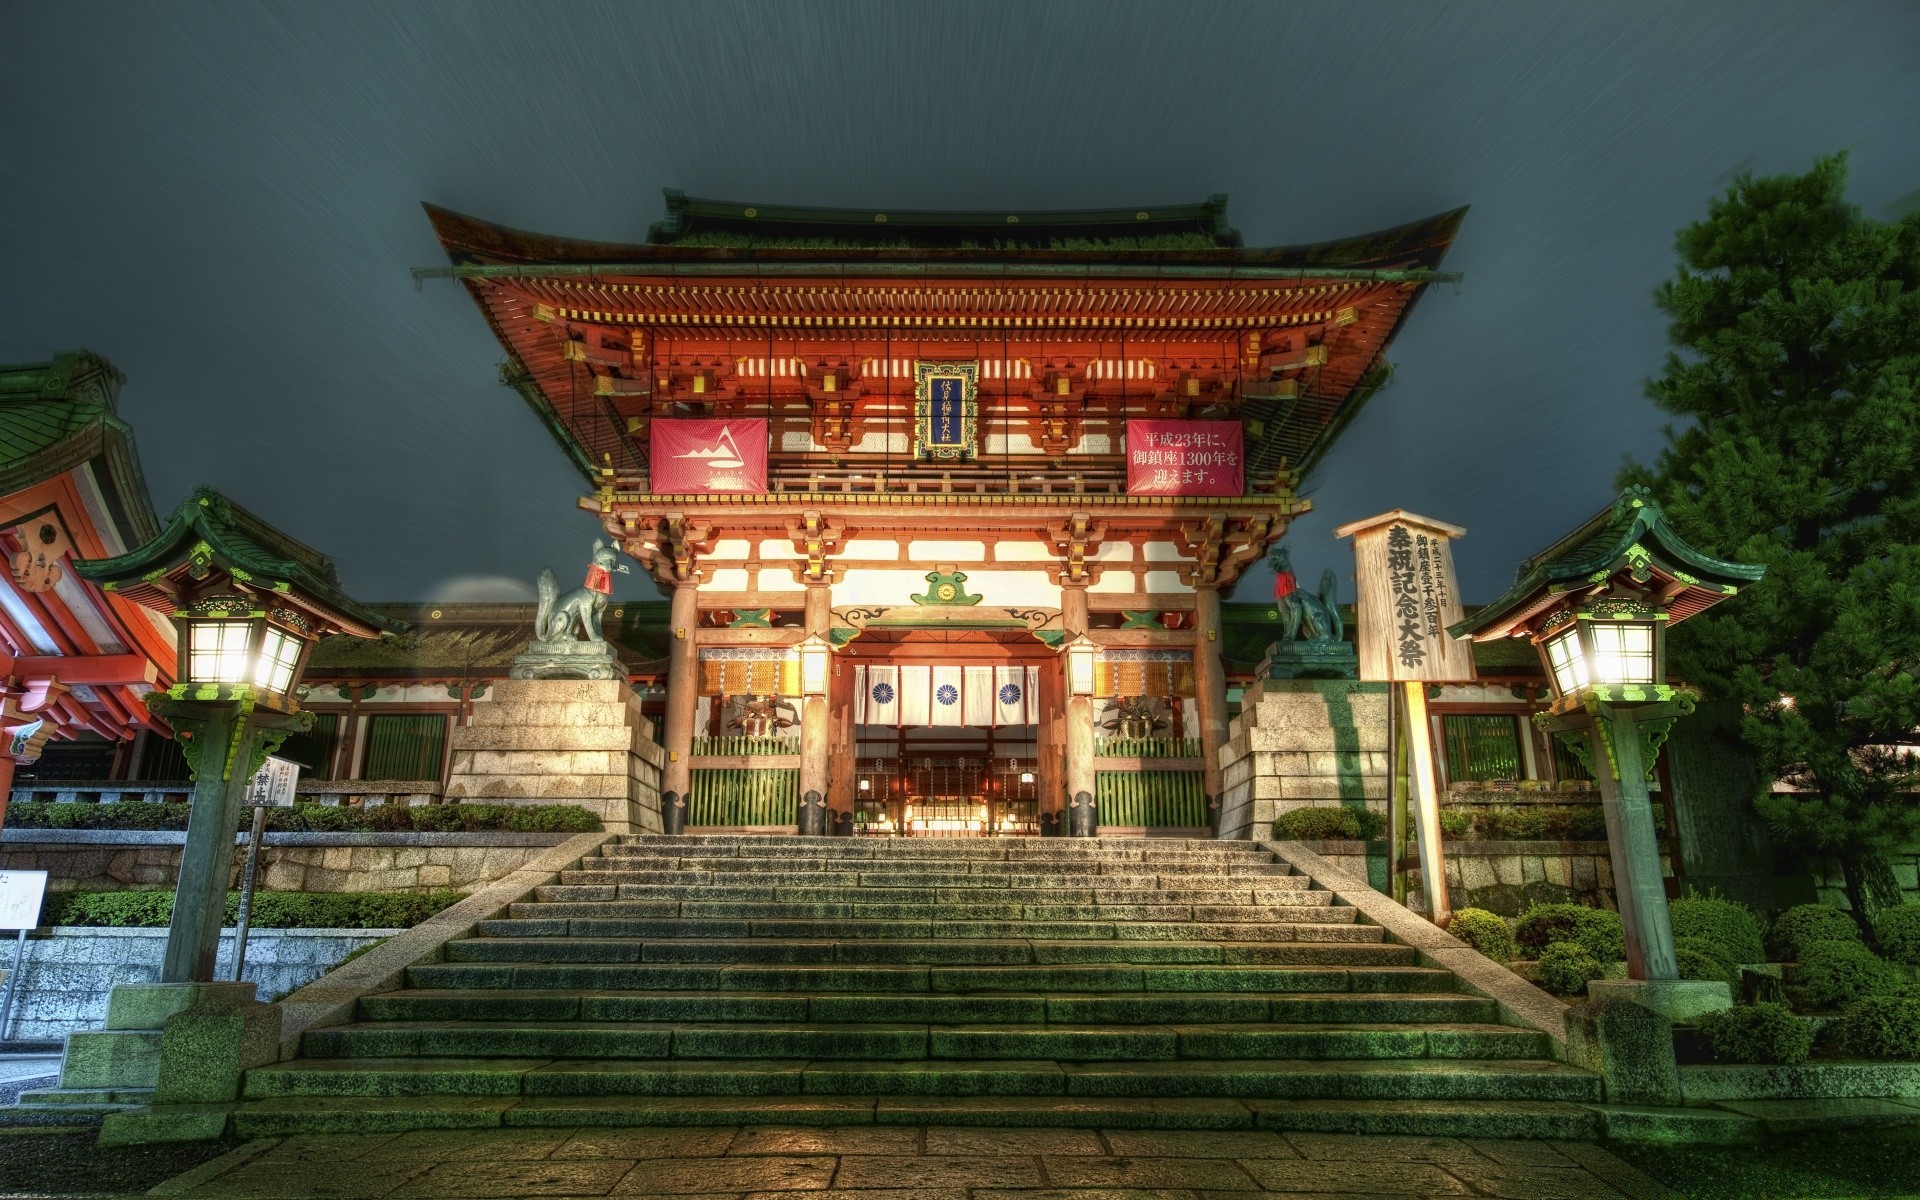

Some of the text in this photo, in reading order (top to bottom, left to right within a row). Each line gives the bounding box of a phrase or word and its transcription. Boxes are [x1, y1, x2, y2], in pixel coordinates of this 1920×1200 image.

[1144, 432, 1226, 448] 平成23年に、
[1132, 450, 1238, 466] 御鎮座1300年を
[1154, 469, 1216, 485] 迎えます。
[1430, 539, 1447, 607] 平成二十三年十月
[1387, 525, 1427, 668] 奉祝記念大祭
